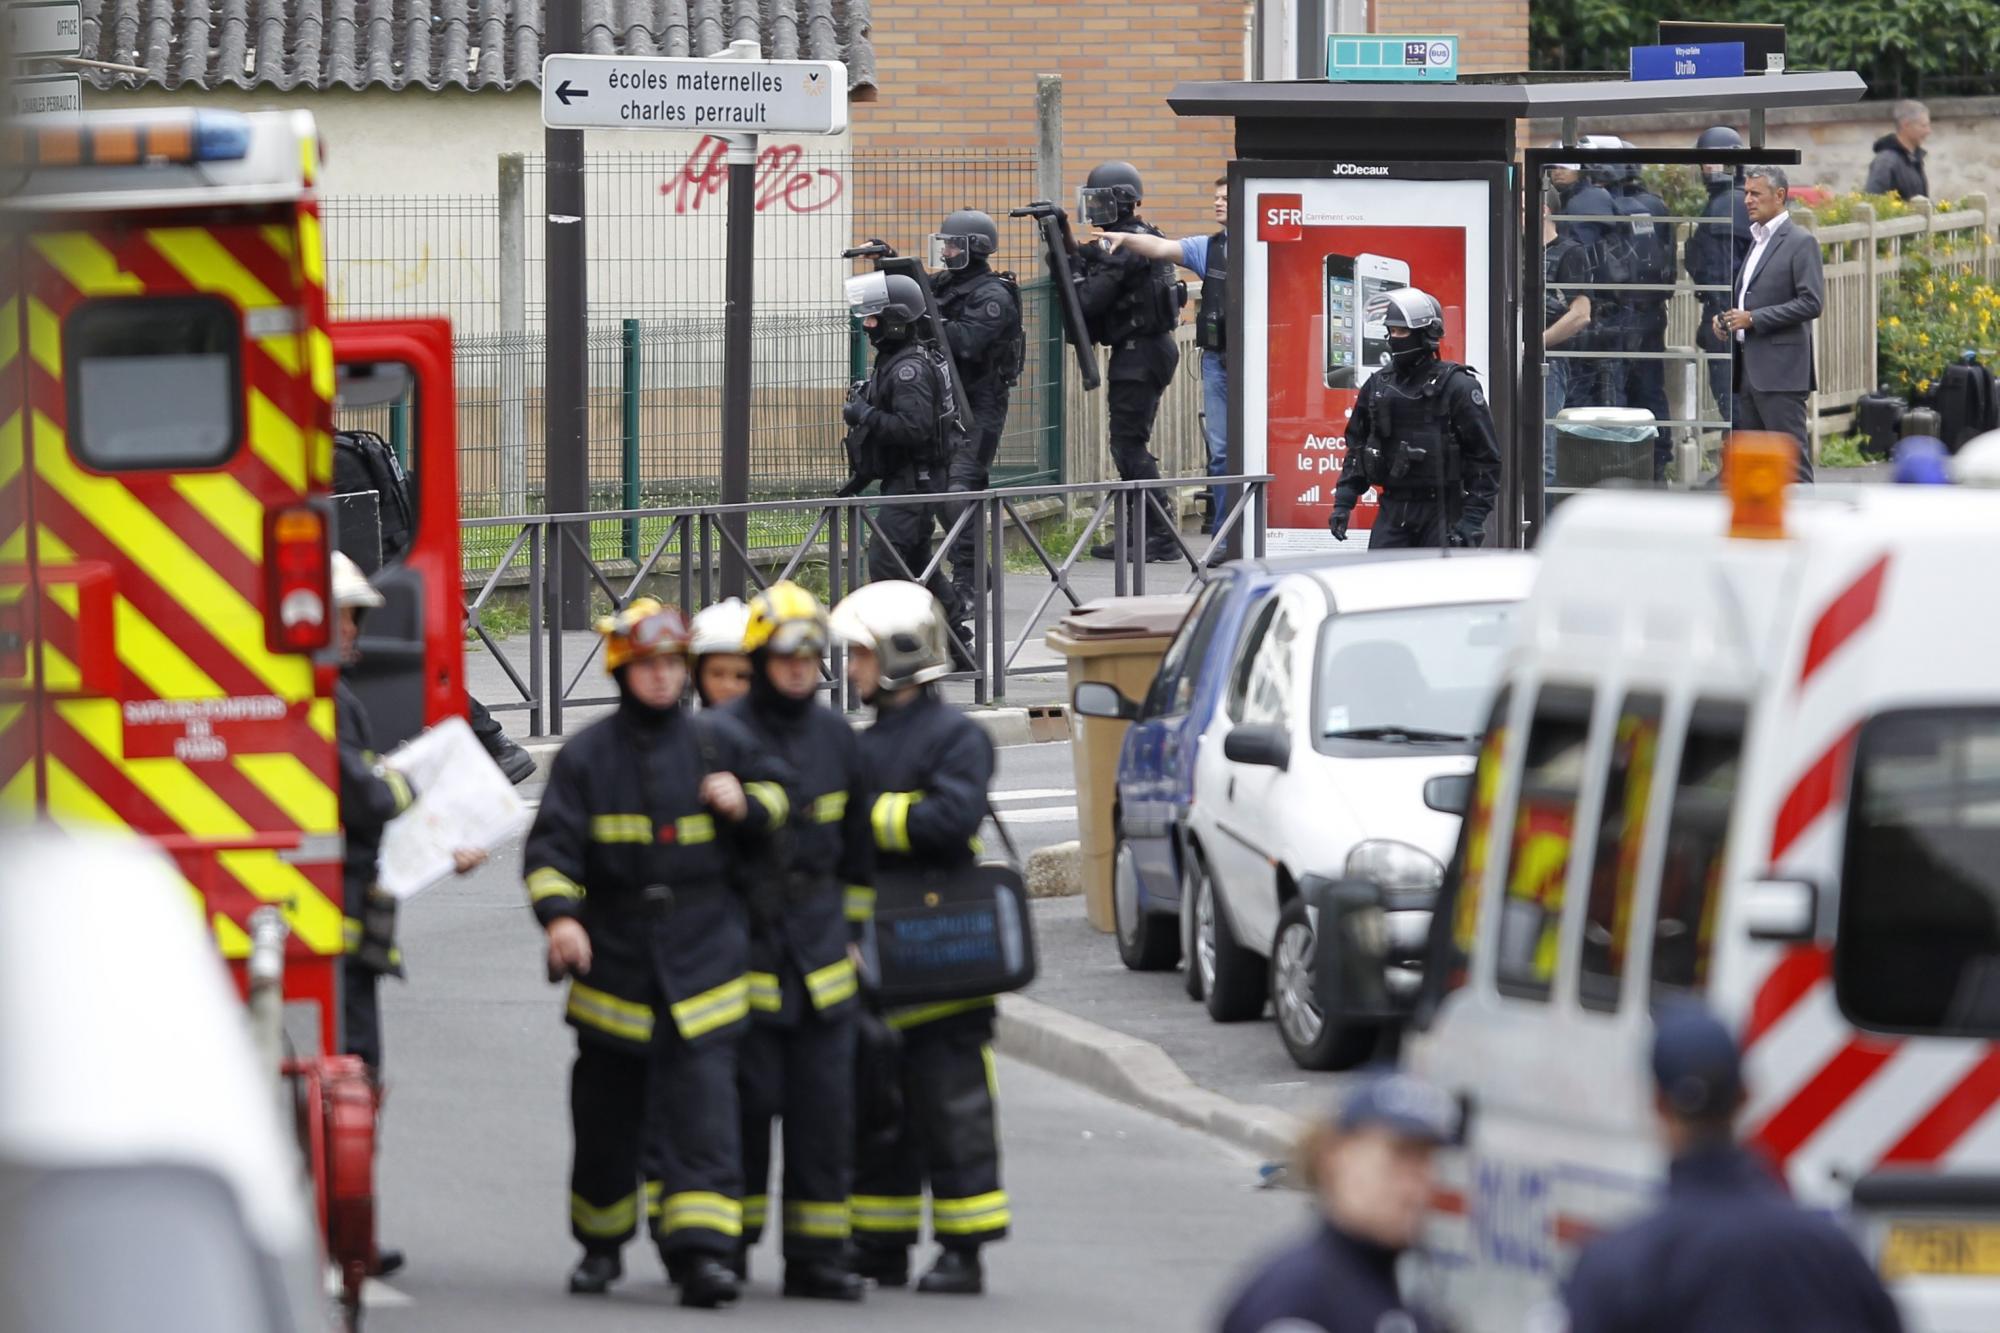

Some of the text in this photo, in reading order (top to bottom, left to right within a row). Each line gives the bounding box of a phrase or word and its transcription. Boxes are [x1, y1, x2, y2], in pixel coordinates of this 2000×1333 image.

[57, 20, 78, 35] OFFICE
[1407, 44, 1425, 54] 132
[1675, 60, 1696, 75] Utrillo
[609, 69, 782, 92] écoles maternelles
[620, 100, 766, 125] charles perrault
[1333, 163, 1389, 175] JCDecaux
[1267, 208, 1302, 226] SFR
[1304, 433, 1346, 450] Avec
[1298, 453, 1344, 475] le plu
